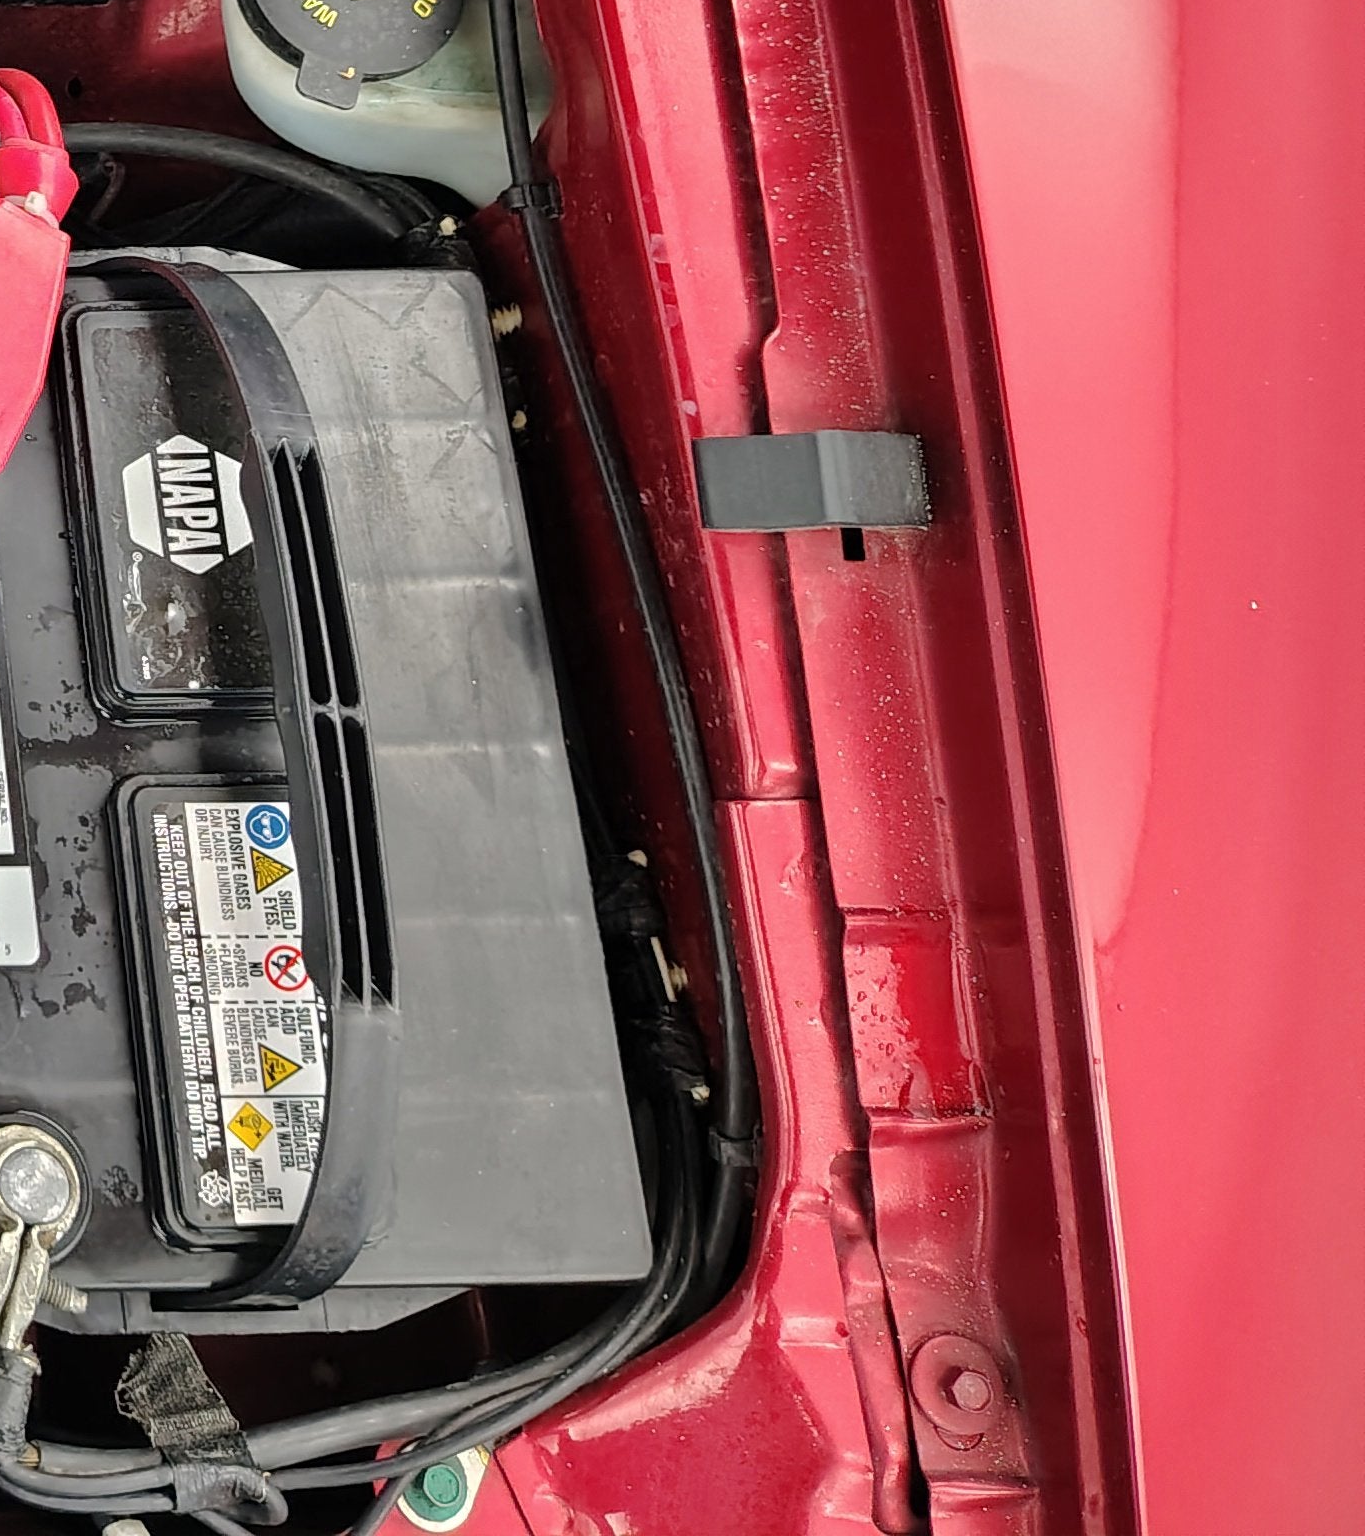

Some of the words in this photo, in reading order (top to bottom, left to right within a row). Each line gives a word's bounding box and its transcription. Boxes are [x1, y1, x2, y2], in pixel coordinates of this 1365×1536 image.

[156, 458, 222, 552] NAPA
[195, 809, 209, 822] OR
[209, 809, 224, 827] CAN
[170, 825, 184, 858] KEEP
[212, 831, 228, 863] CAUSE
[225, 808, 245, 870] EXPLOSIVE
[153, 814, 177, 914] INSTRUCTIONS.
[175, 861, 188, 888] OUT
[177, 890, 190, 908] OF
[217, 866, 234, 921] BLINDNESS
[233, 874, 250, 910] GASES
[180, 909, 194, 935] THE
[263, 897, 279, 930] EYES.
[277, 890, 296, 929] SHIELD
[167, 922, 181, 942] DO
[5, 946, 11, 956] 5
[170, 945, 184, 972] NOT
[184, 938, 198, 981] REACH
[248, 962, 263, 977] NO
[173, 975, 189, 1010] OPEN
[189, 986, 202, 1004] OF
[222, 1008, 238, 1046] SEVERE
[251, 1008, 266, 1041] CAUSE
[266, 1008, 279, 1028] CAN
[280, 1007, 296, 1034] ACID
[177, 1014, 197, 1076] BATTERY!
[191, 1007, 214, 1080] CHILDREN.
[237, 1008, 256, 1064] BLINDNESS
[296, 1007, 317, 1064] SULFURIC
[185, 1081, 200, 1101] DO
[244, 1068, 257, 1082] OR
[188, 1104, 204, 1131] NOT
[200, 1083, 218, 1121] READ
[273, 1101, 289, 1128] WITH
[192, 1137, 207, 1161] TIP.
[207, 1124, 221, 1151] ALL
[277, 1131, 294, 1172] WATER.
[289, 1100, 311, 1172] IMMEDIATELY
[230, 1147, 246, 1178] HELP
[235, 1181, 251, 1214] FAST.
[247, 1158, 268, 1211] MEDICAL
[267, 1187, 283, 1210] GET
